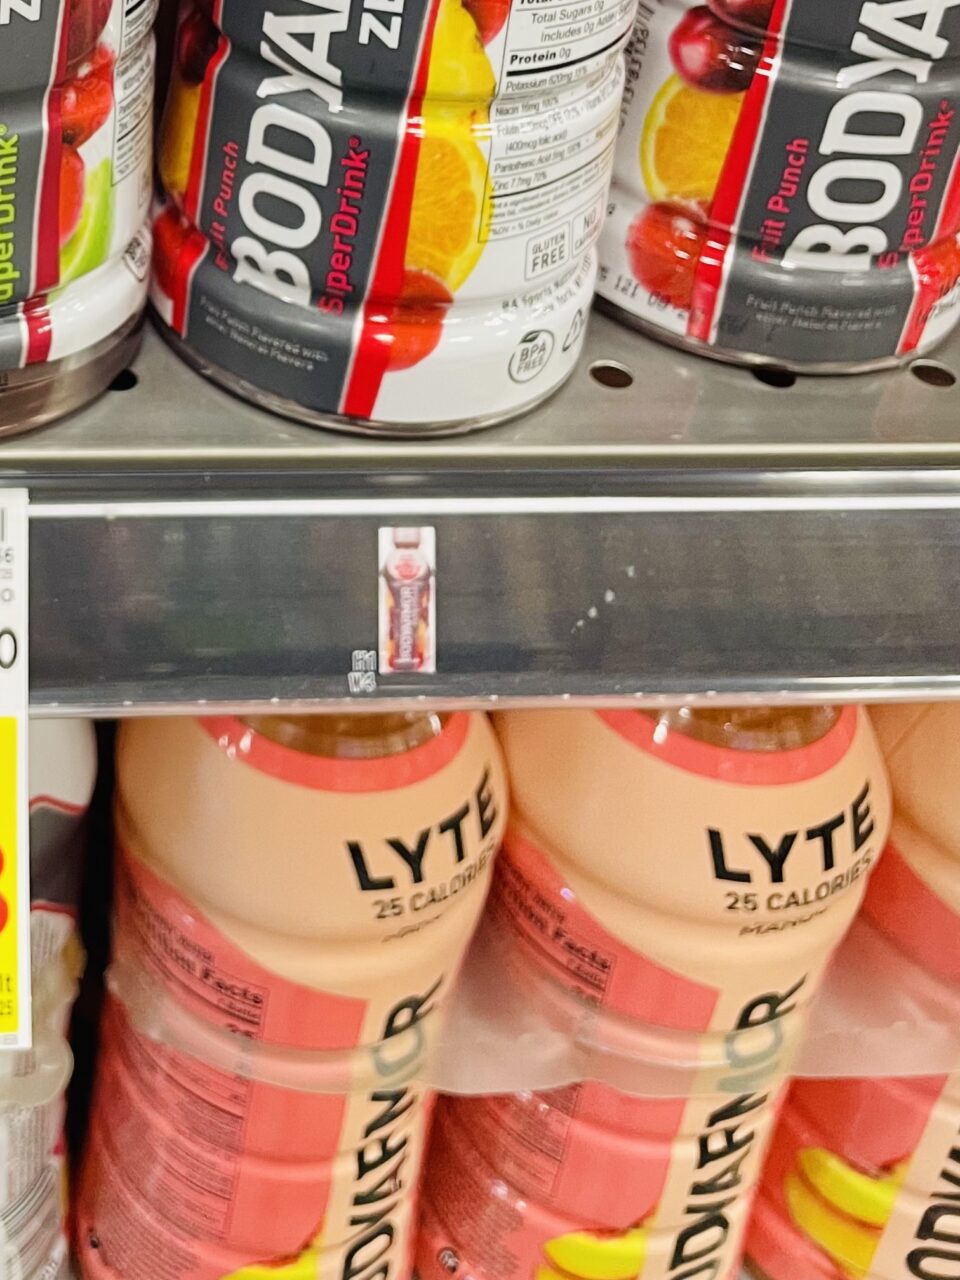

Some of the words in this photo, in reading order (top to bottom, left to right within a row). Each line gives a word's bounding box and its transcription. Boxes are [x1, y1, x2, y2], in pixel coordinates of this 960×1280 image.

[532, 10, 557, 25] Total
[559, 4, 593, 22] Sugars
[541, 26, 582, 43] Includes
[510, 50, 557, 66] Protein
[559, 46, 572, 60] 0g
[213, 141, 239, 218] Punch
[767, 136, 810, 216] Punch
[532, 232, 566, 255] GLUTEN
[532, 244, 566, 272] FREE
[519, 341, 547, 363] BPA
[346, 767, 498, 891] LYTE
[707, 779, 876, 885] LYTE
[726, 891, 758, 911] 25
[766, 850, 875, 911] CALORIES
[373, 896, 404, 919] 25
